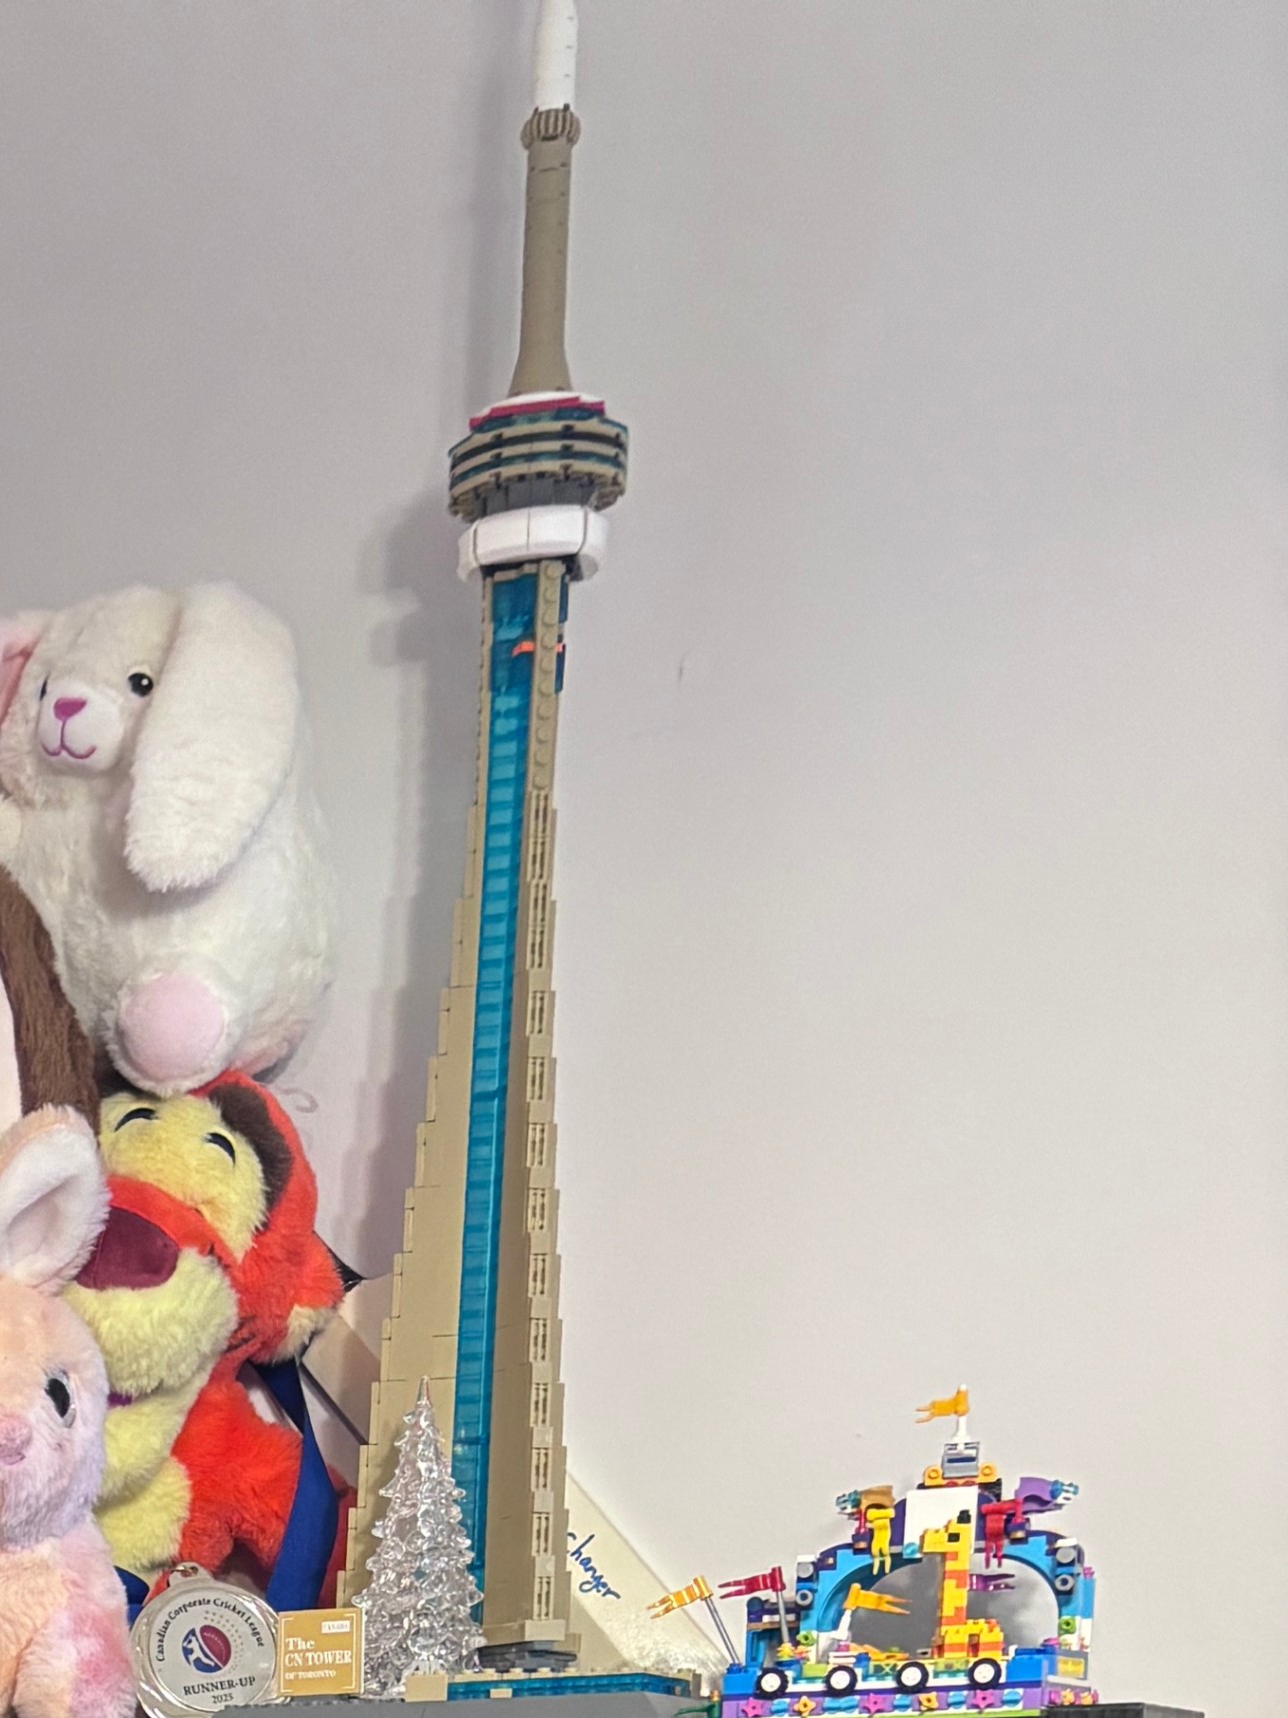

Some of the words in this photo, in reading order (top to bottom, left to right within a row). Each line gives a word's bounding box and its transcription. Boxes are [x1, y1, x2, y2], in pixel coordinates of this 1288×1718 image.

[167, 1597, 212, 1621] Corporate
[212, 1597, 246, 1619] Cricket
[244, 1614, 266, 1648] League
[285, 1637, 316, 1651] The
[284, 1651, 303, 1668] CN
[305, 1649, 353, 1667] TOWER
[182, 1675, 257, 1697] RUNNER-UP
